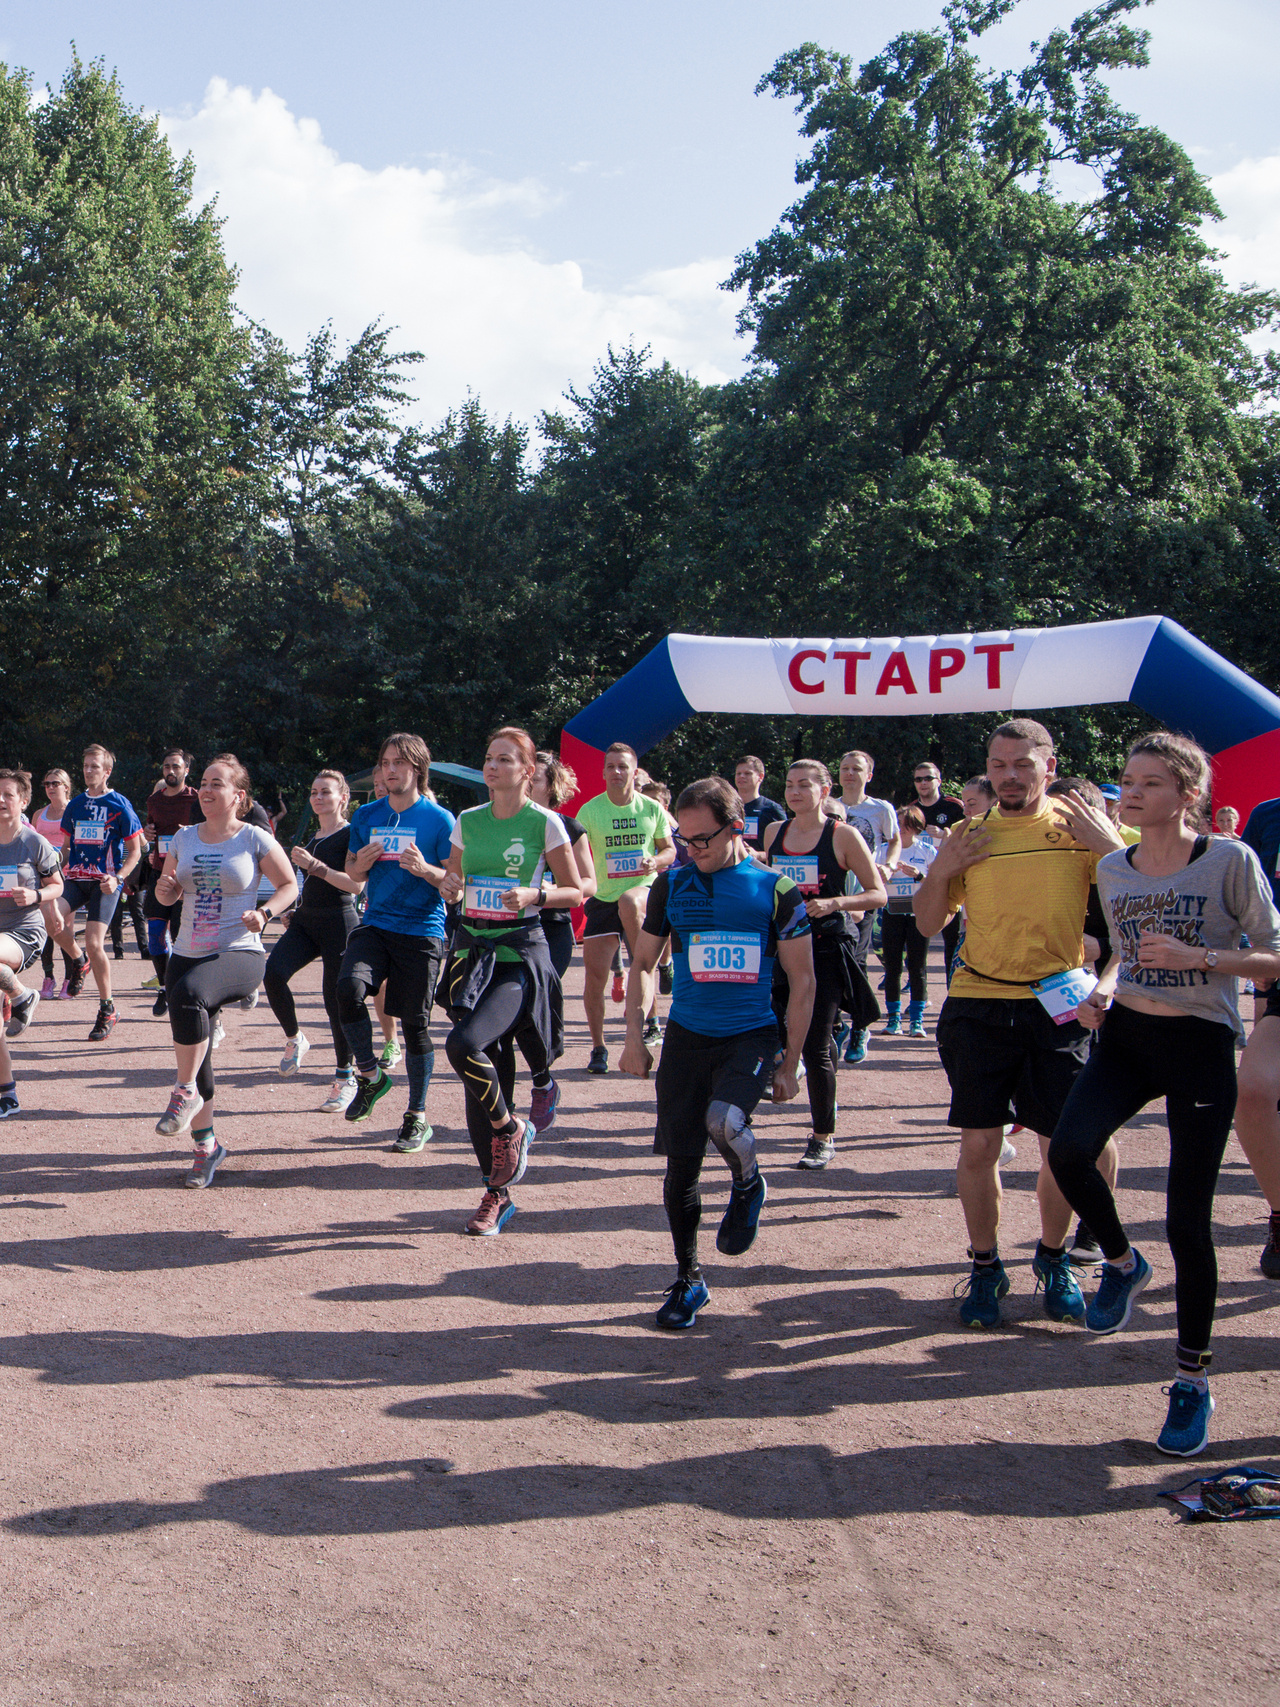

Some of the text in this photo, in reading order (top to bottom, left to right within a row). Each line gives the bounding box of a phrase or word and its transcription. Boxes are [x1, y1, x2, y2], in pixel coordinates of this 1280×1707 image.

[788, 643, 1014, 695] СТАРТ
[612, 818, 637, 829] RUN
[80, 827, 98, 839] 285
[383, 836, 400, 852] 24
[605, 834, 646, 847] EVERY
[614, 858, 637, 872] 209
[781, 867, 806, 883] 105
[896, 885, 912, 895] 121
[668, 898, 713, 909] Reebok
[703, 946, 746, 970] 303
